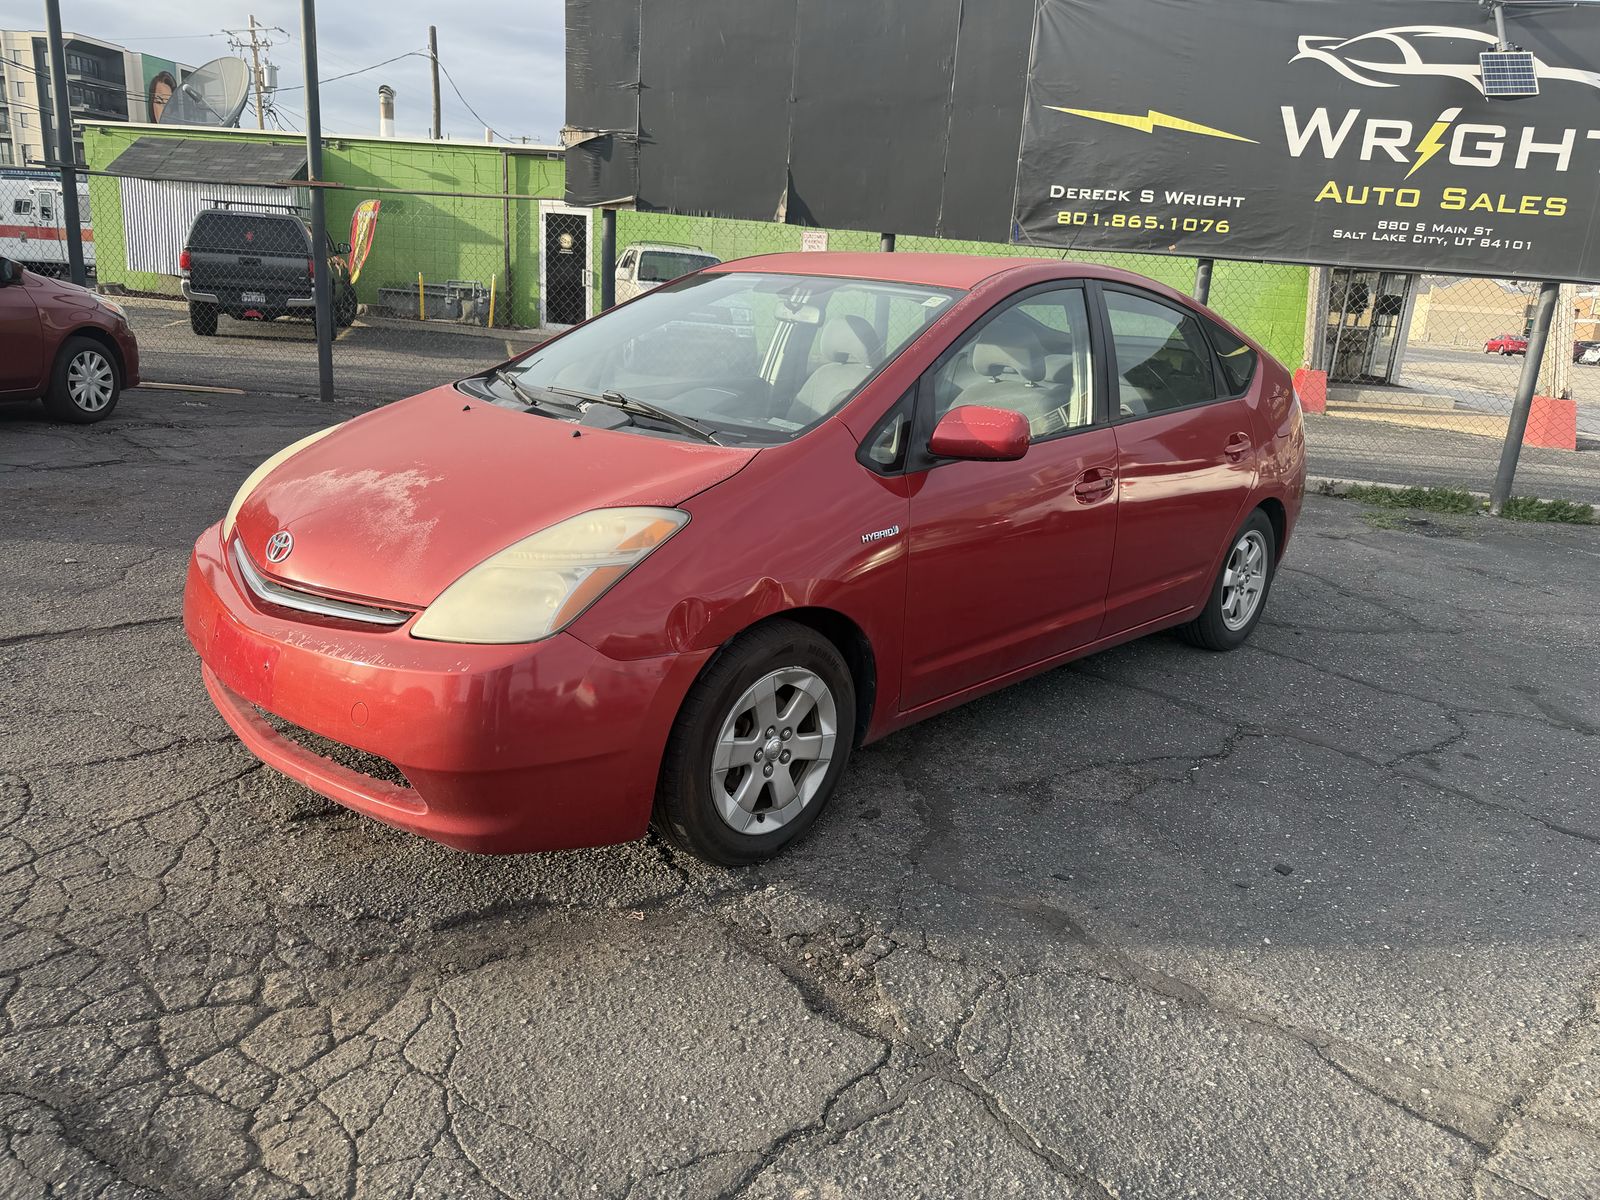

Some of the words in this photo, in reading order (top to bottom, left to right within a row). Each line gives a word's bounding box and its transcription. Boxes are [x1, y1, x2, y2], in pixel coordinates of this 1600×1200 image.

[1280, 106, 1600, 180] WRIGH
[1050, 184, 1131, 202] DERECK
[1140, 189, 1155, 203] S
[1164, 190, 1246, 208] WRIGHT
[1314, 180, 1421, 208] AUTO
[1440, 187, 1568, 217] SALES
[1057, 211, 1231, 234] 801.865.1076
[1377, 220, 1410, 231] 880
[1415, 222, 1426, 232] S
[1431, 223, 1467, 235] MAIN
[1473, 226, 1494, 236] ST
[1332, 229, 1367, 240] SALT
[1371, 231, 1407, 243] LAKE
[1412, 233, 1448, 247] CITY,
[1454, 236, 1476, 247] UT
[1480, 237, 1532, 251] 84101
[861, 527, 894, 543] HYBRID
